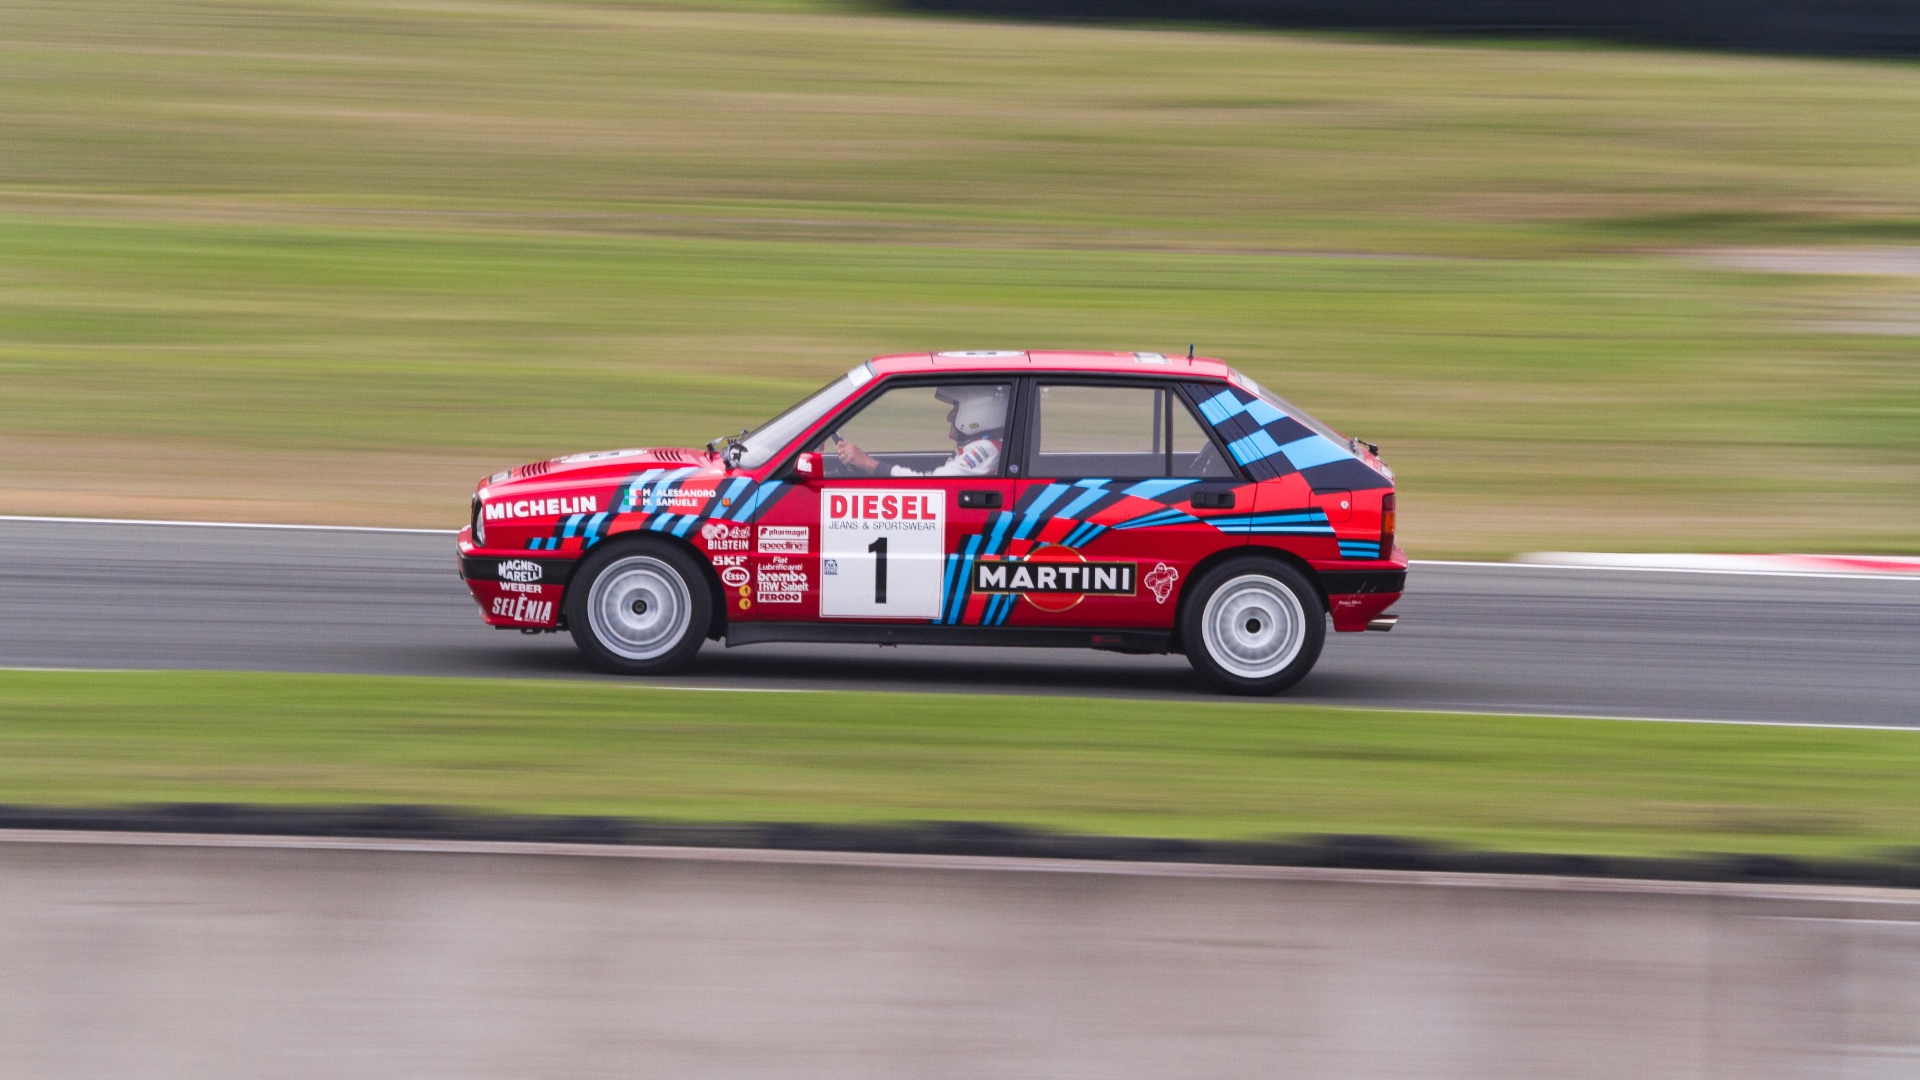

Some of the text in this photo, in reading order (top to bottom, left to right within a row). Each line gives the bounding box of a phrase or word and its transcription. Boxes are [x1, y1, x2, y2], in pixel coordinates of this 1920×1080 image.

[656, 488, 717, 498] ALESSANDRO
[485, 495, 597, 520] MICHELIN
[656, 498, 698, 507] SAMUELE
[830, 495, 936, 520] DIESEL
[829, 520, 936, 531] JEANS & SPORTSWEAR
[769, 528, 807, 537] pharmagel
[707, 540, 749, 550] BILSTEIN
[759, 541, 803, 551] speedline
[712, 555, 748, 566] SKF
[773, 556, 789, 564] Fiat
[498, 559, 542, 574] MAGNETI
[757, 563, 803, 571] Lubrificanti
[868, 537, 887, 604] 1
[726, 571, 746, 581] Esso
[757, 570, 808, 582] brembo
[979, 565, 1131, 590] MARTINI
[499, 581, 542, 594] WEBER
[757, 580, 809, 592] TRW Sabelt
[760, 593, 800, 602] FERODO
